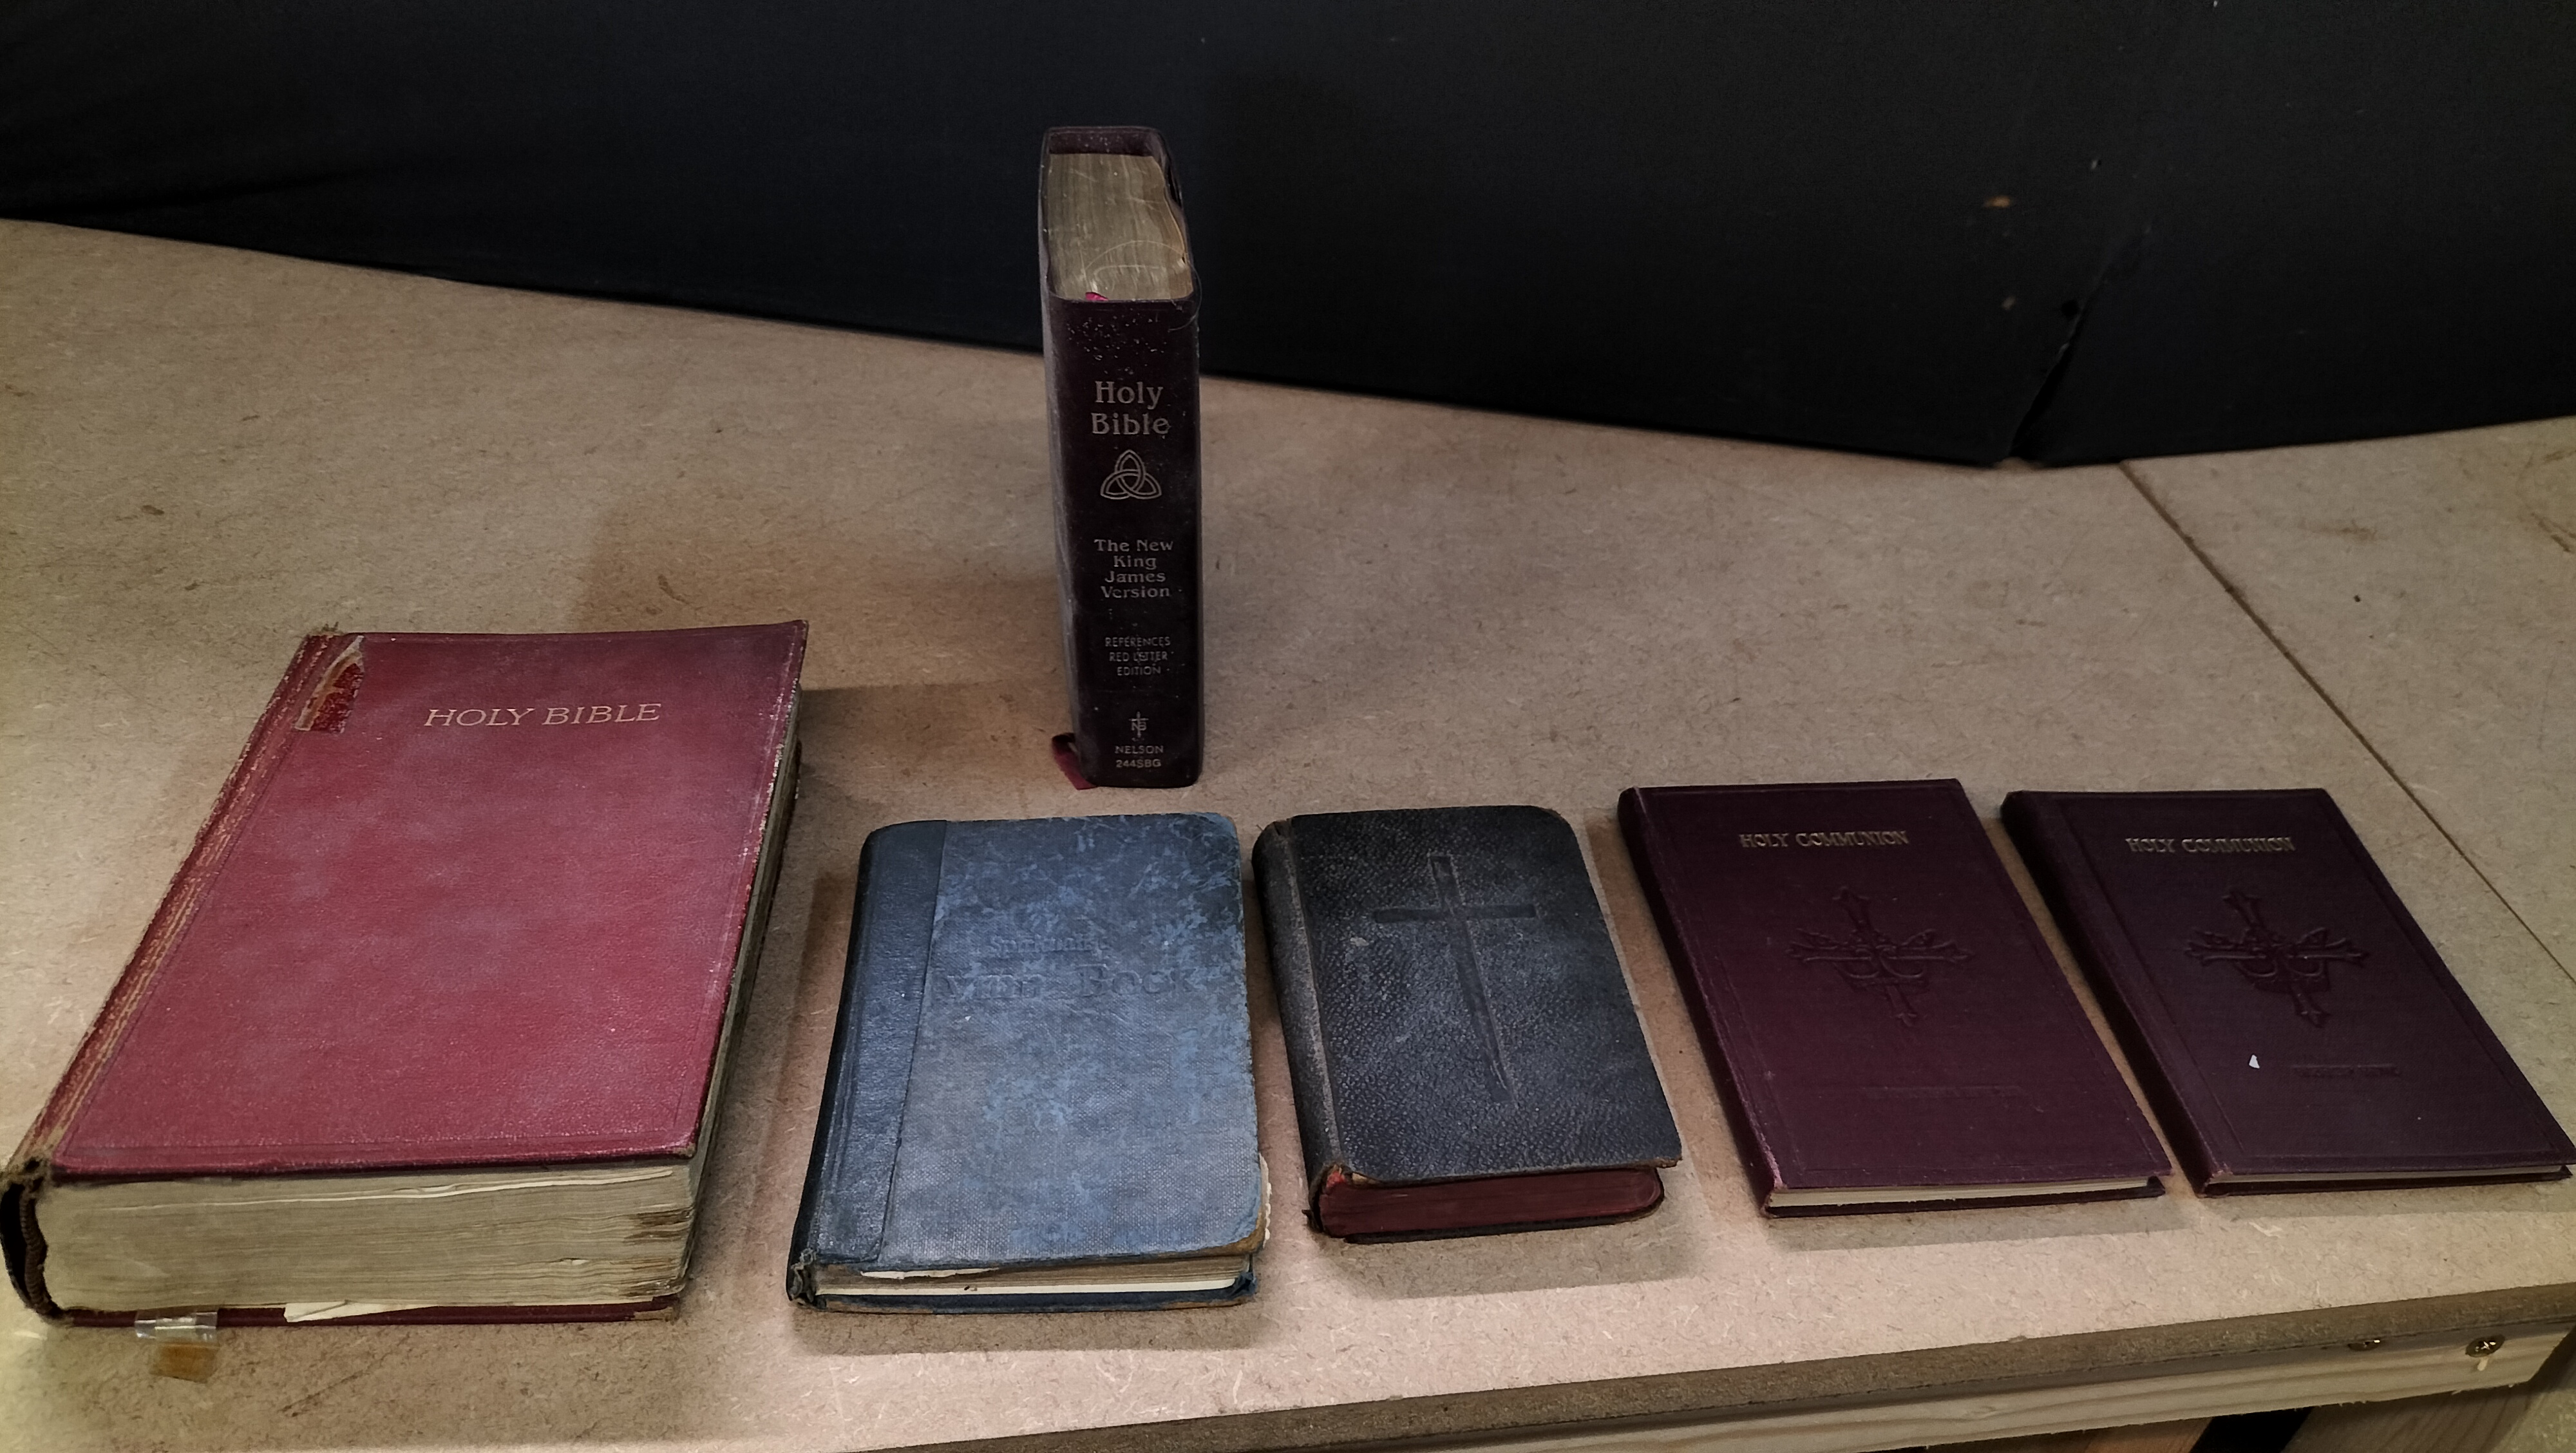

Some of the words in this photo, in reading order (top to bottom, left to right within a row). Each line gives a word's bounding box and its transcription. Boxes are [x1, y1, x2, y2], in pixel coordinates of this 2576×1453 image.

[1095, 381, 1163, 410] Holy
[1091, 412, 1171, 435] Bible
[1094, 539, 1130, 551] The
[1137, 539, 1173, 551] New
[1113, 555, 1157, 569] King
[1105, 571, 1166, 583] James
[1101, 585, 1170, 598] Version
[1105, 636, 1171, 647] REFERENCES
[1109, 652, 1130, 661] RED
[1133, 651, 1168, 661] LETTER
[1117, 666, 1161, 676] EDITION
[424, 708, 534, 726] HOLY
[542, 703, 661, 725] BIBLE
[1115, 745, 1164, 754] NELSON
[1115, 759, 1161, 768] 244SBG
[1739, 833, 1789, 848] HOLY
[1795, 830, 1909, 846] COMMUNION
[2125, 838, 2175, 852] HOLY
[2182, 837, 2296, 852] COMMUNION
